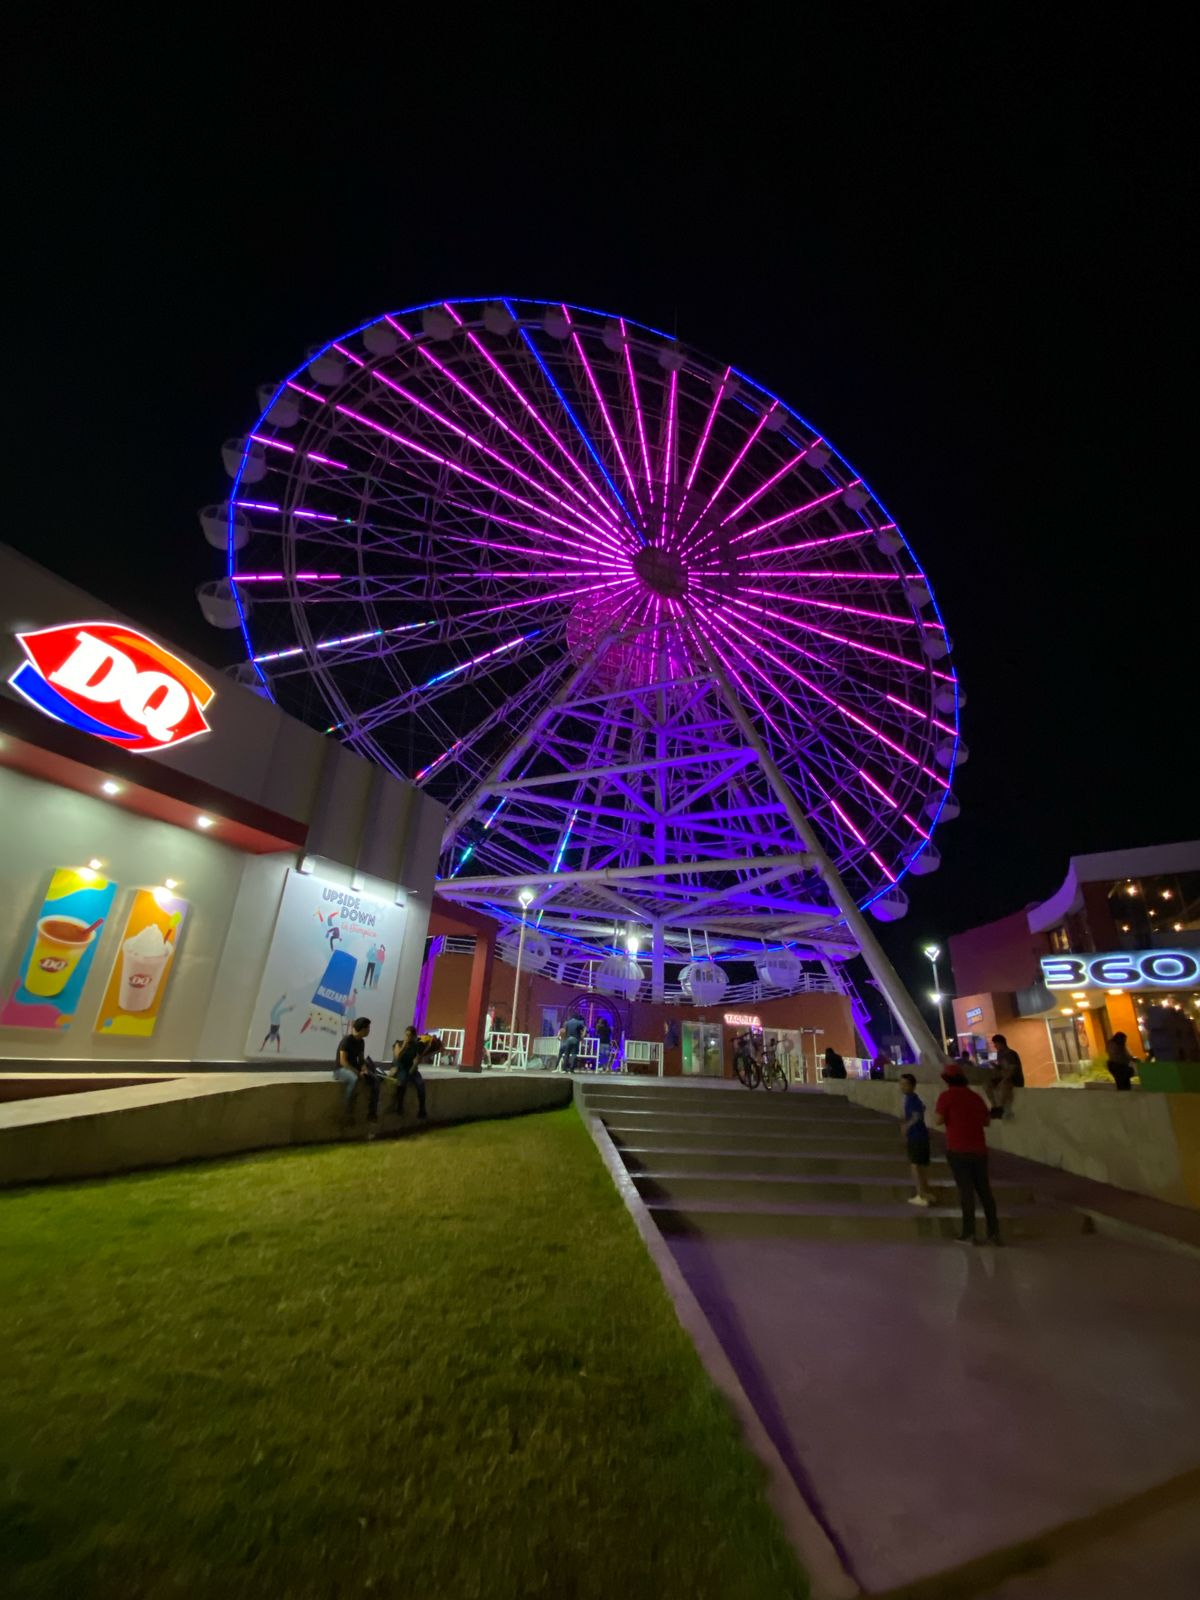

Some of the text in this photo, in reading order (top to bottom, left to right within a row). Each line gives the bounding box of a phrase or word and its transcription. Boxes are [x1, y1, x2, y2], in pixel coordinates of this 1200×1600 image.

[48, 631, 190, 741] DQ
[322, 888, 361, 910] UPSIDE
[340, 907, 376, 927] DOWN
[40, 958, 68, 972] DQ
[1041, 953, 1198, 988] 360
[129, 974, 152, 987] DQ
